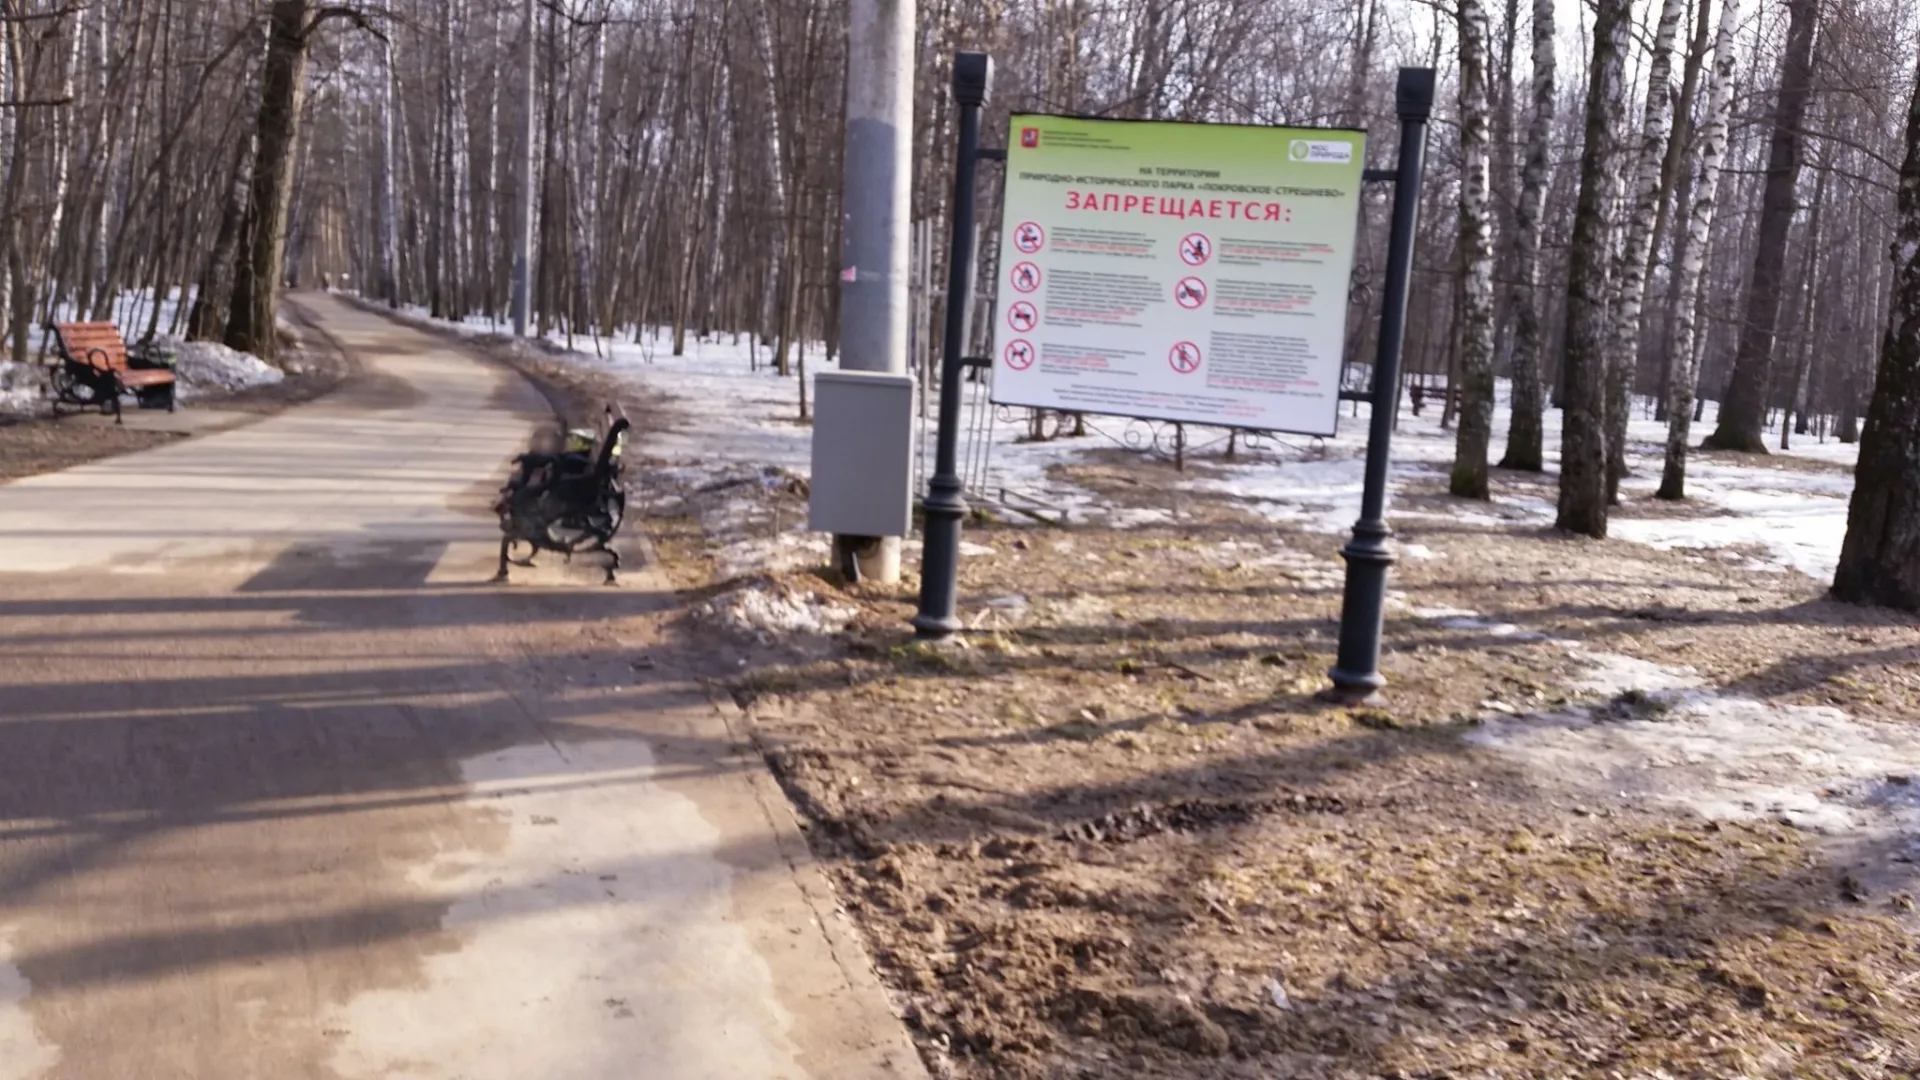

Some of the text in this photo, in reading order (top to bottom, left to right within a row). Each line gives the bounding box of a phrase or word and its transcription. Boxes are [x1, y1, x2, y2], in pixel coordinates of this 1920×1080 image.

[1019, 171, 1346, 198] ПРИРОДНО-ИСТОРИЧЕСКОГО ПАРКА «ПОКРОВСКОЕ-СТРЕШНЕВО»
[1139, 166, 1221, 178] НА ТЕРРИТОРИИ
[1065, 190, 1292, 222] ЗАПРЕЩАЕТСЯ:
